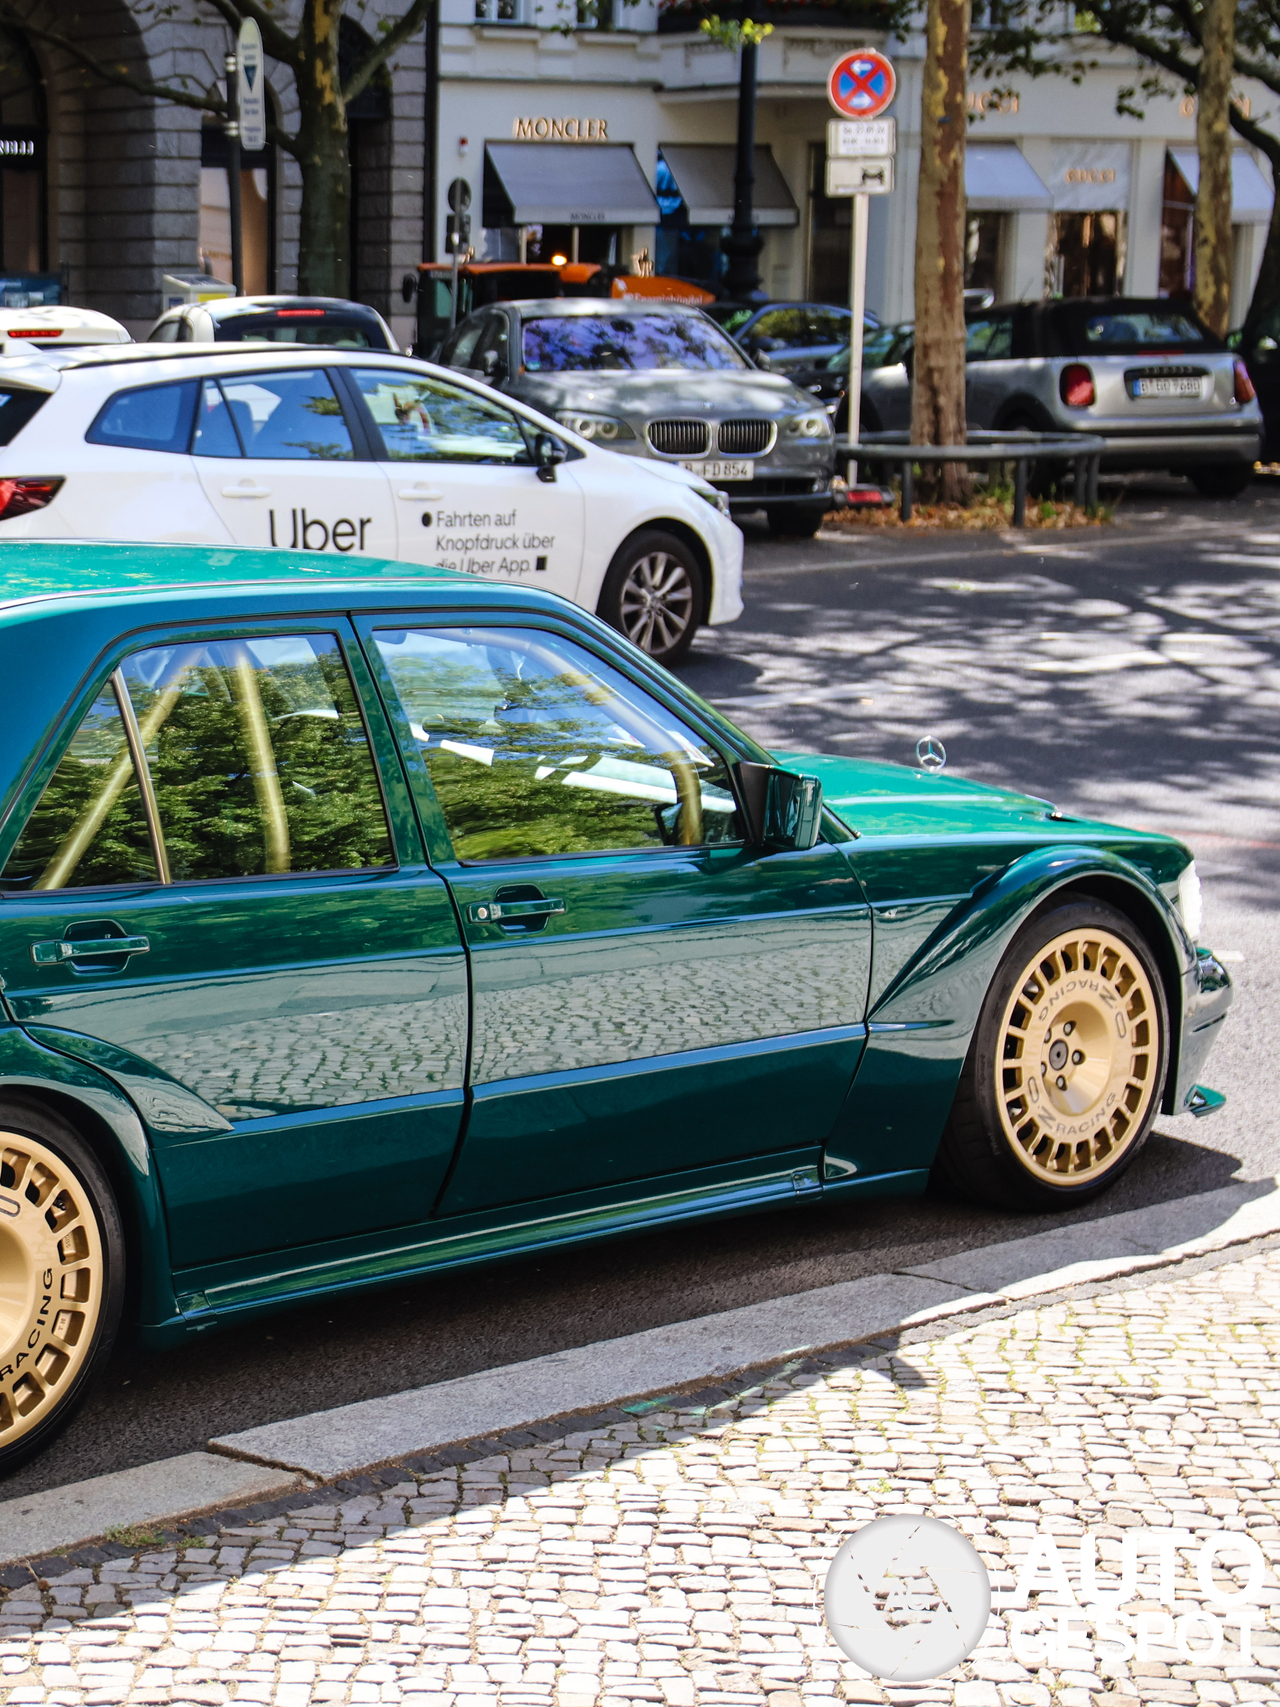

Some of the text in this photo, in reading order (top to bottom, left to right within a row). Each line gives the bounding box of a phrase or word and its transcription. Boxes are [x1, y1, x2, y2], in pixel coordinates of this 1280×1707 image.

[513, 117, 608, 140] MONCLER
[570, 212, 606, 222] MONCLER
[703, 462, 721, 476] FD
[724, 462, 748, 476] 854
[270, 508, 372, 551] Uber
[436, 508, 517, 528] Fahrten auf
[436, 532, 555, 555] Knopfdruck über
[460, 557, 495, 574] Uber
[498, 557, 531, 576] App.
[1039, 979, 1099, 1022] RACING
[1055, 1092, 1117, 1136] RACING
